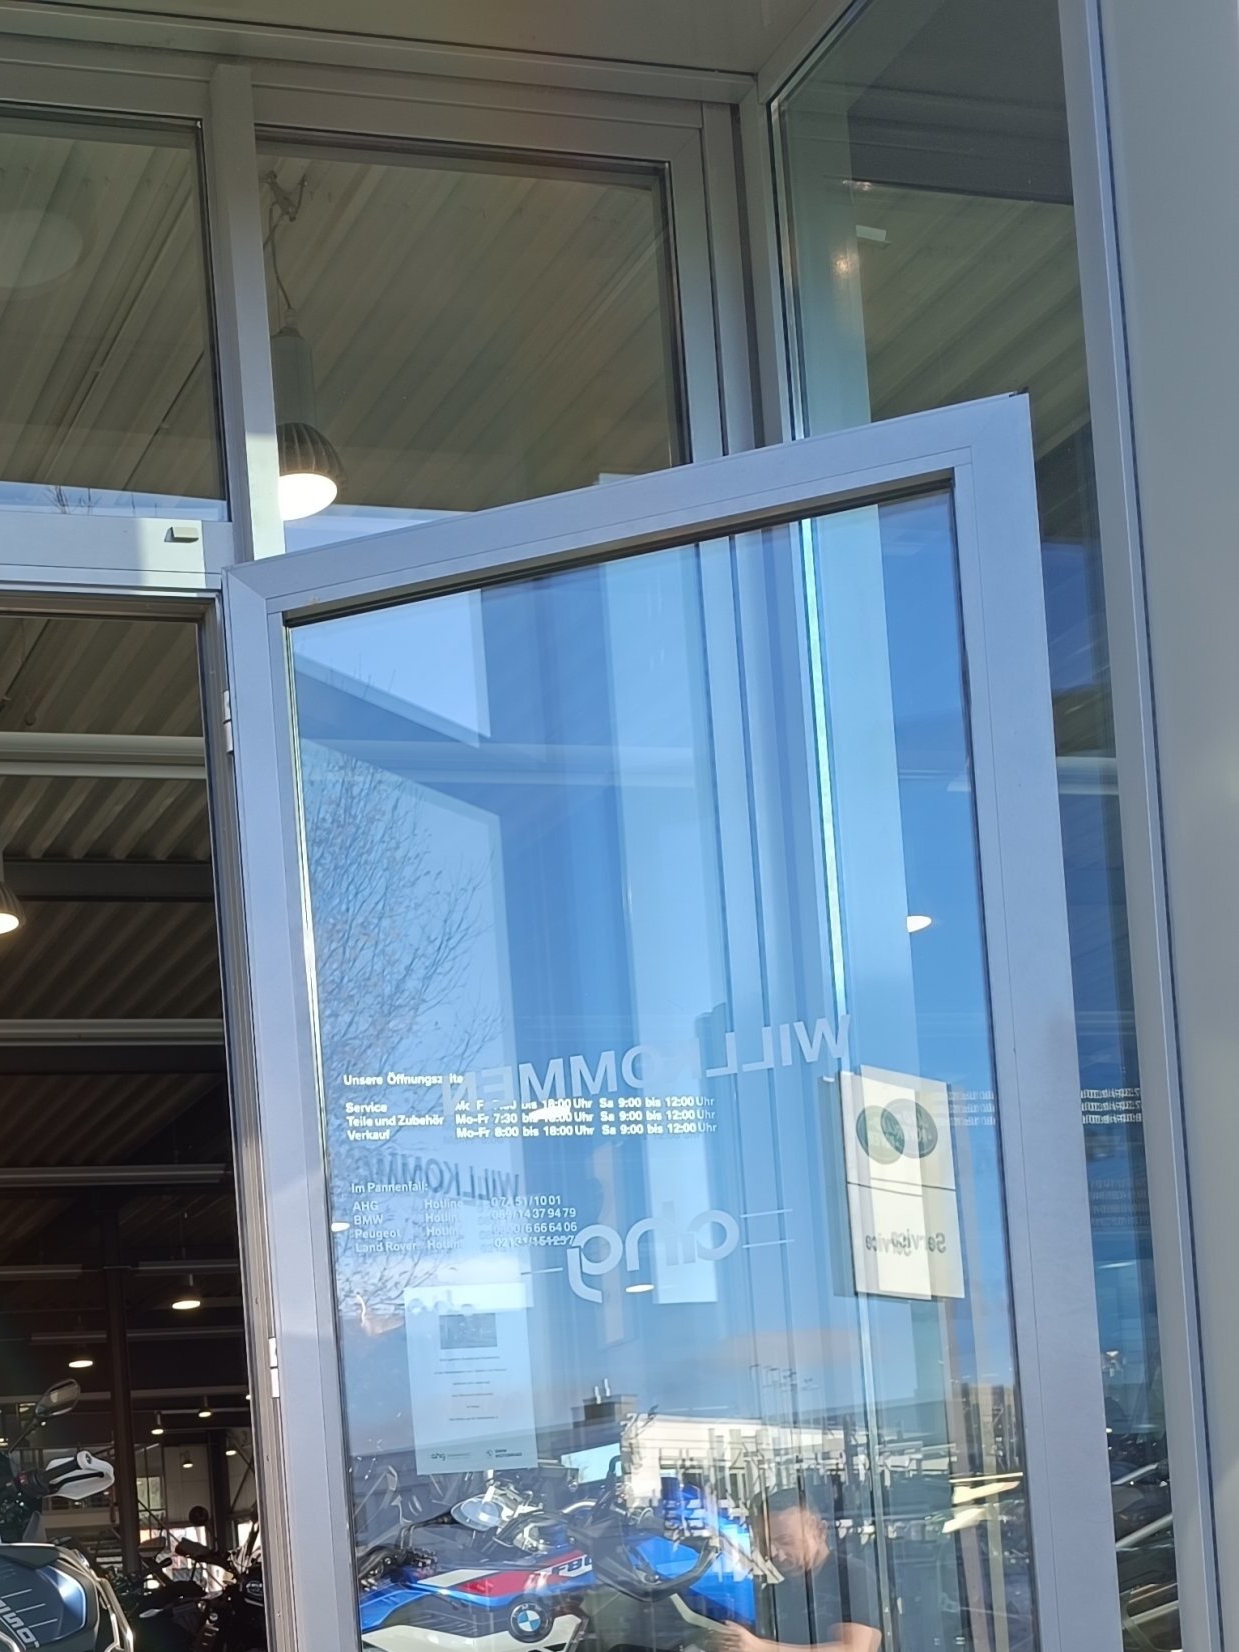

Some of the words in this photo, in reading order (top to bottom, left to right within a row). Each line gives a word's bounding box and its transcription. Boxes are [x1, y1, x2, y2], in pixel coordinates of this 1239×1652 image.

[343, 1074, 383, 1086] Unsere
[345, 1101, 388, 1113] Service
[573, 1097, 593, 1108] Uhr
[599, 1097, 614, 1108] Sa
[618, 1097, 642, 1107] 9:00
[645, 1096, 661, 1107] bis
[665, 1096, 695, 1107] 12:00
[696, 1096, 715, 1106] Uhr
[346, 1115, 374, 1127] Teile
[375, 1115, 396, 1126] und
[398, 1113, 444, 1126] Zubehör
[456, 1113, 490, 1124] Mo-Fr
[493, 1113, 518, 1124] 7:30
[574, 1111, 594, 1122] Uhr
[601, 1111, 615, 1121] Sa
[619, 1110, 642, 1121] 9:00
[646, 1110, 662, 1120] bis
[666, 1110, 695, 1120] 12:00
[697, 1109, 716, 1120] Uhr
[347, 1128, 391, 1141] Verkauf
[456, 1127, 491, 1138] Mo-Fr
[523, 1125, 539, 1136] bis
[575, 1125, 595, 1135] Uhr
[602, 1124, 616, 1135] Sa
[620, 1124, 644, 1135] 9:00
[647, 1123, 663, 1134] bis
[667, 1123, 697, 1134] 12:00
[698, 1123, 717, 1133] Uhr
[351, 1183, 365, 1193] Im
[367, 1181, 429, 1193] Pannenfall:
[353, 1201, 379, 1211] AHG
[353, 1214, 383, 1225] BMW
[355, 1242, 383, 1253] Land
